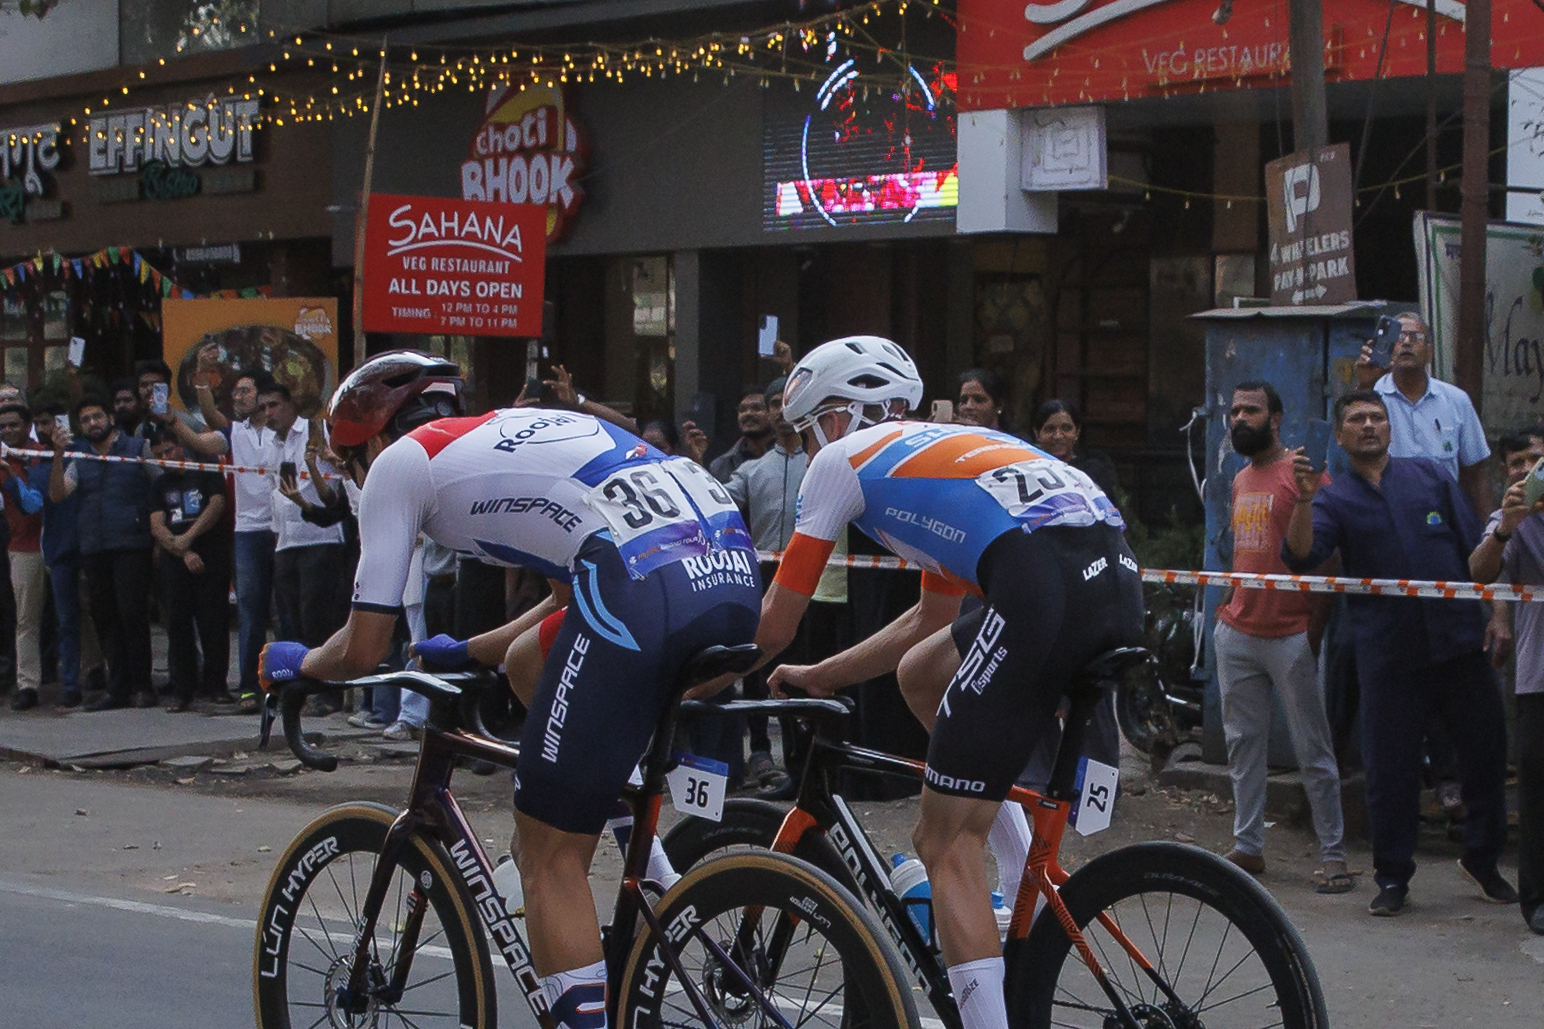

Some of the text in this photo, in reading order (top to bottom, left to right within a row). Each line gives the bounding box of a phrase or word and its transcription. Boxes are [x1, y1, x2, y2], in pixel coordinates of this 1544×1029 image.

[1193, 42, 1292, 76] RESTAUR
[461, 154, 575, 209] BHOOK
[1284, 163, 1321, 234] P
[388, 204, 522, 253] SAHANA
[402, 255, 511, 275] VEG RESTAURANT
[388, 278, 523, 299] ALL DAYS OPEN
[392, 306, 432, 319] TIMING
[456, 303, 472, 314] PM
[476, 303, 490, 314] TO
[502, 304, 518, 315] PM
[450, 316, 466, 327] PM
[470, 317, 484, 328] TO
[502, 318, 518, 329] PM
[602, 470, 681, 530] 36
[991, 461, 1067, 505] 25
[470, 497, 583, 533] WINSPACE
[884, 506, 968, 544] POLYGON
[1083, 557, 1109, 582] LAZER
[1118, 553, 1139, 574] LAZER
[691, 575, 756, 592] INSURANCE
[541, 633, 591, 764] WINSPACE
[685, 776, 710, 808] 36
[1087, 782, 1109, 813] 25
[282, 836, 340, 902] HYPER
[449, 838, 551, 1016] WINSPACE
